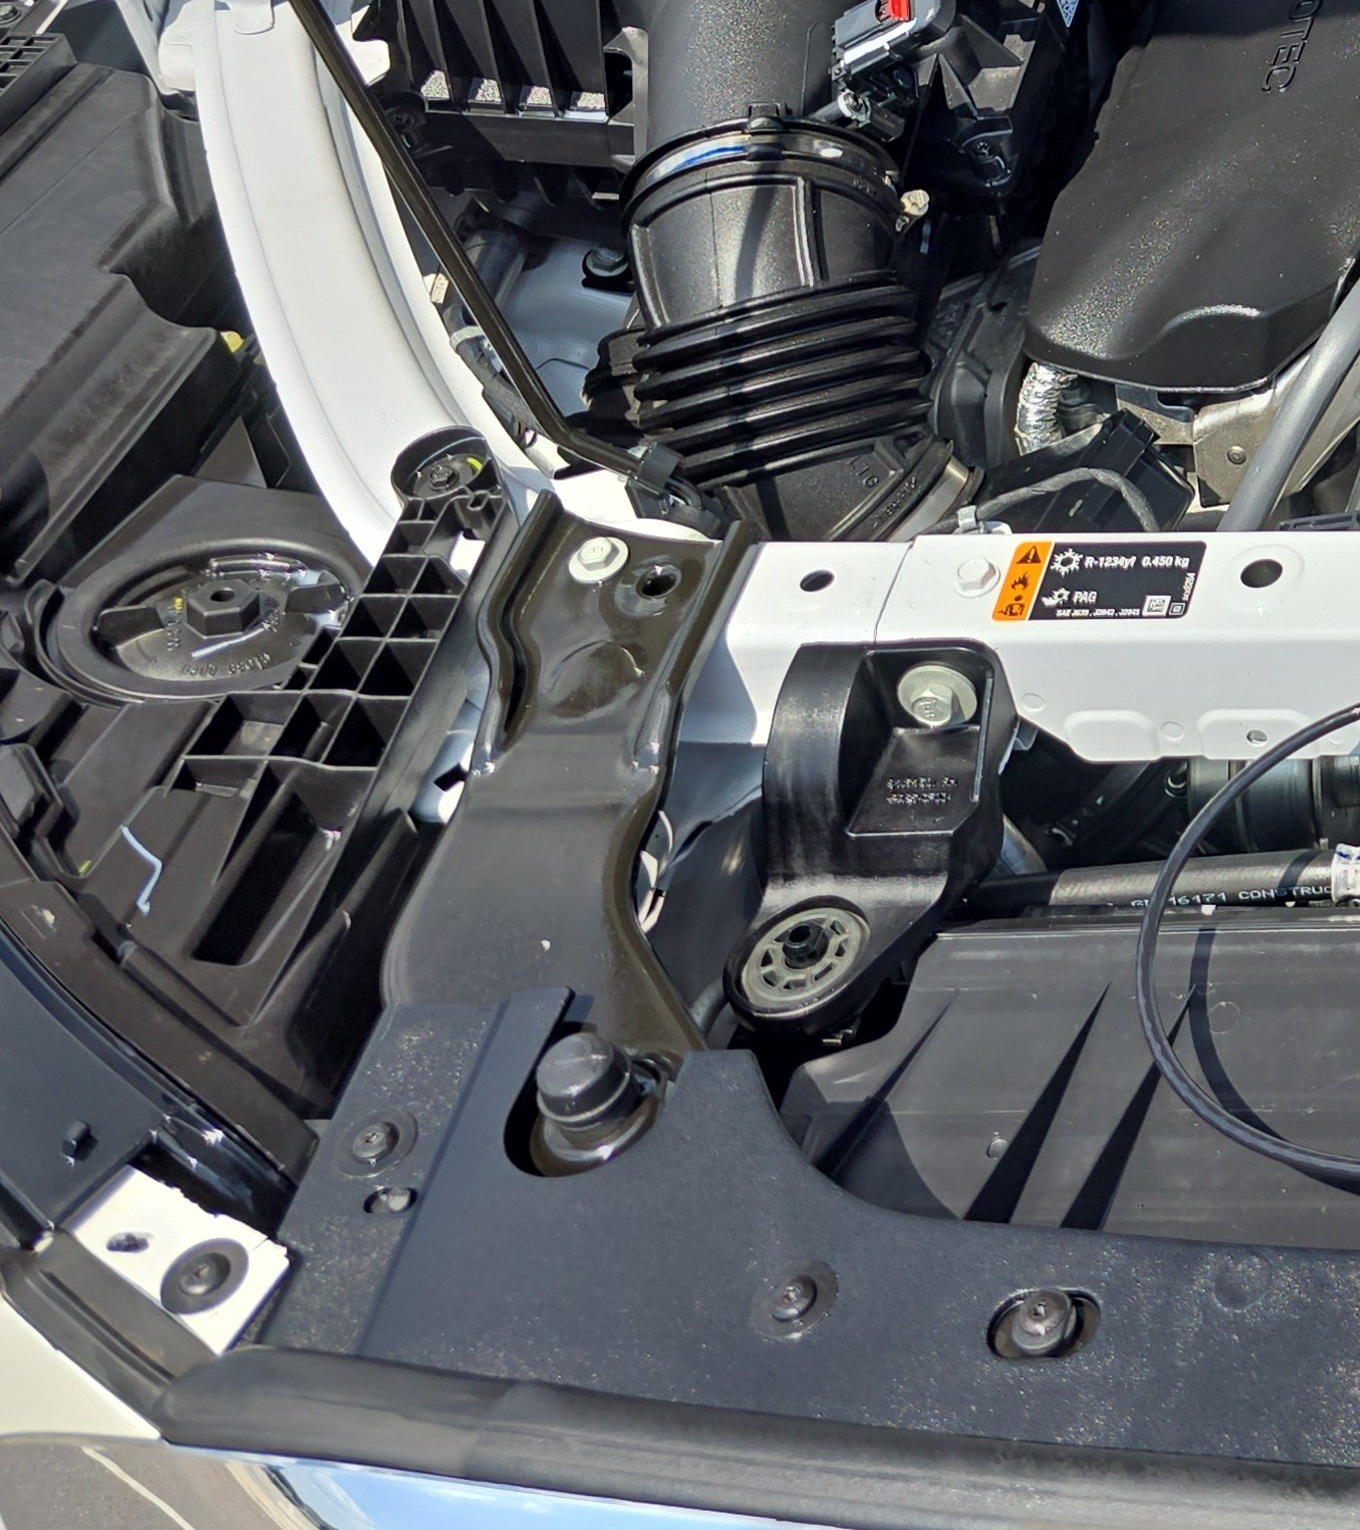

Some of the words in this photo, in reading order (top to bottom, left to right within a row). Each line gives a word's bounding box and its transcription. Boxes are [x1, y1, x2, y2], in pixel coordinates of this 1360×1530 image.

[1084, 556, 1136, 570] R-1234yf
[1142, 556, 1173, 567] 0.450
[1174, 556, 1190, 569] kg
[1073, 591, 1098, 603] PAG
